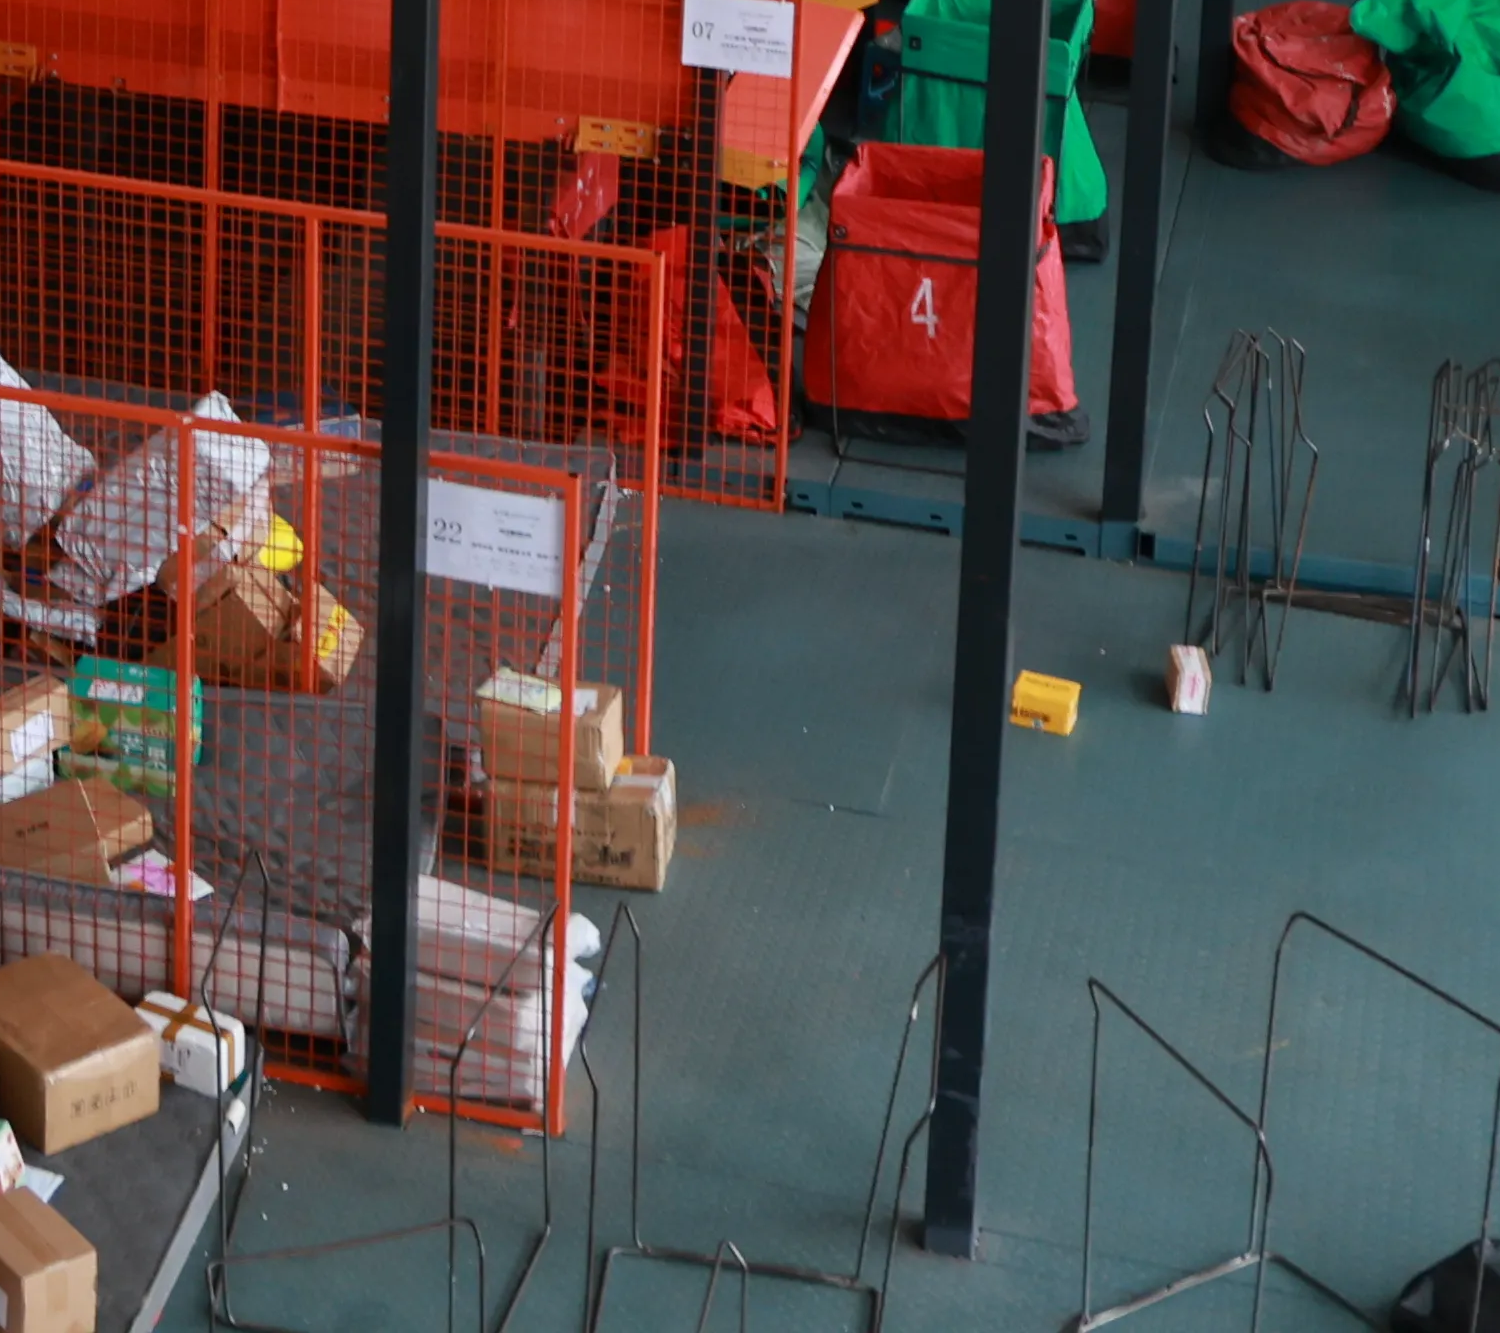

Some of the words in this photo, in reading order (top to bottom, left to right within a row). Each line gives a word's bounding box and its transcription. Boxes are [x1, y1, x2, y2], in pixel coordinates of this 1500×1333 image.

[692, 21, 715, 41] 07
[911, 278, 938, 338] 4
[433, 517, 463, 545] 22
